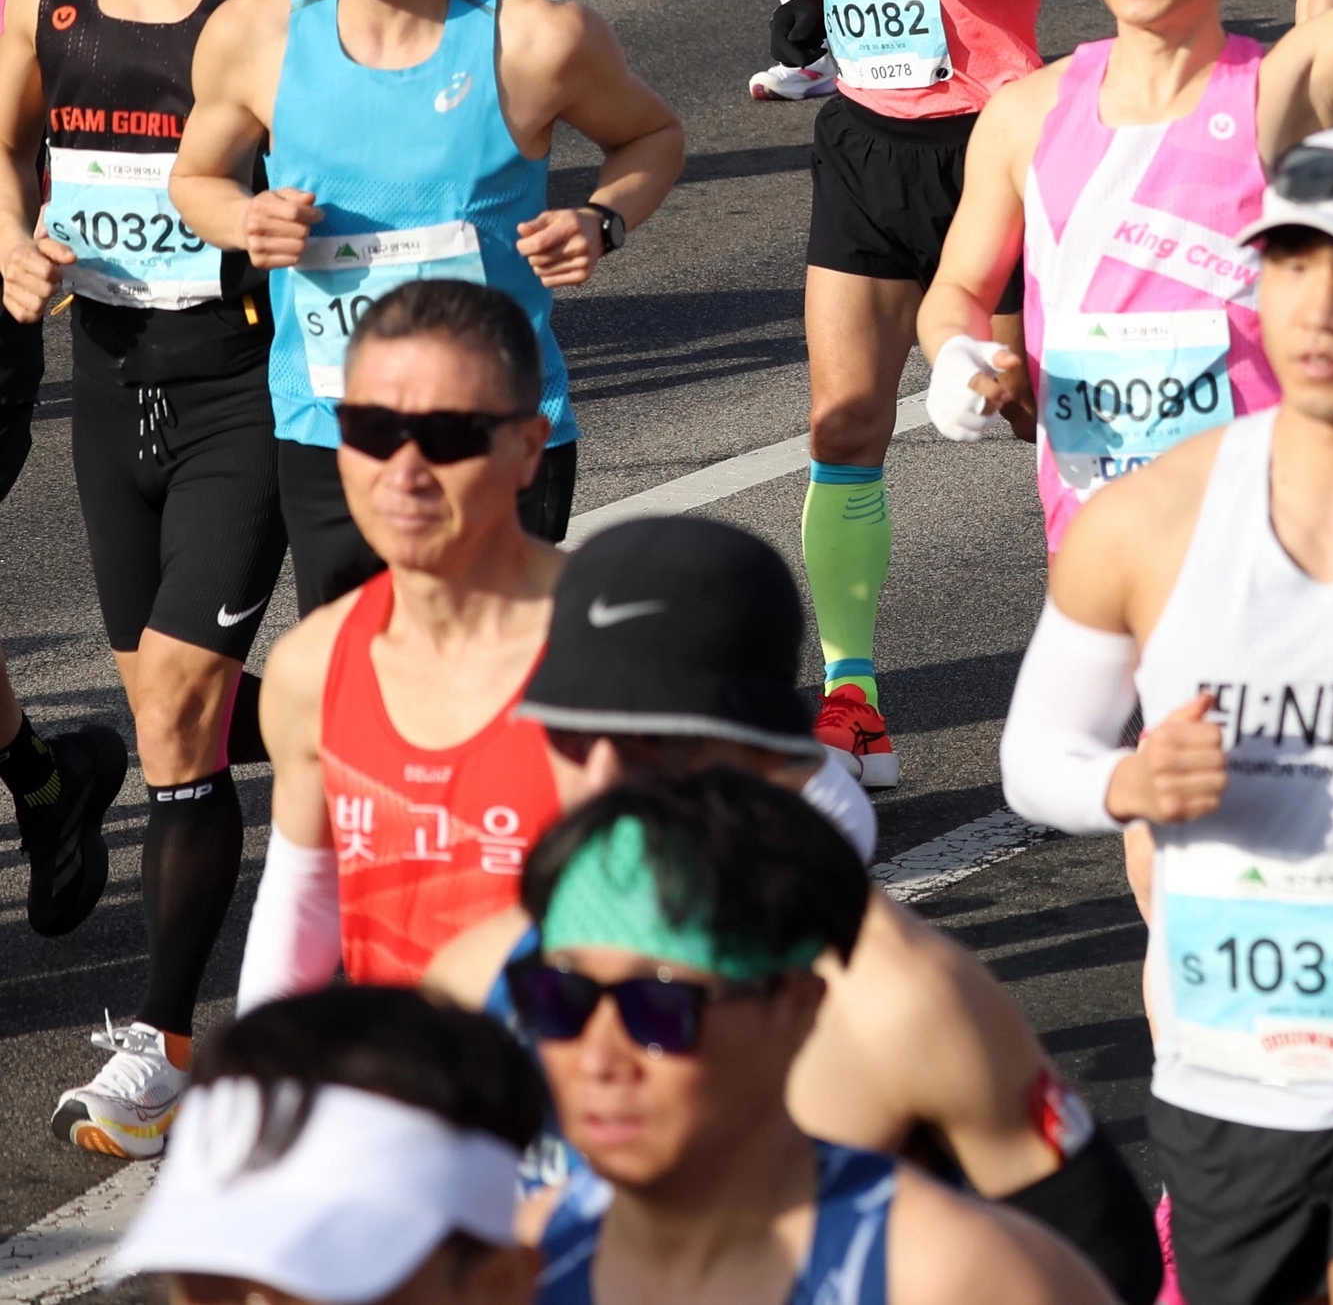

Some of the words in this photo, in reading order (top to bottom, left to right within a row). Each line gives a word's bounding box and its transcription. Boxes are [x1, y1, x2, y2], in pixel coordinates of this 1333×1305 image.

[832, 0, 929, 38] 10182
[871, 63, 913, 80] 00278
[50, 106, 106, 133] TEAM
[112, 110, 187, 139] GORIL
[113, 165, 162, 177] 대구광역시
[52, 222, 71, 242] S
[71, 210, 206, 253] 10329
[1113, 219, 1180, 260] King
[1185, 245, 1262, 286] Crew
[306, 312, 325, 337] S
[1054, 393, 1073, 421] S
[1075, 371, 1219, 423] 10080
[156, 783, 213, 803] cep
[335, 795, 528, 875] 빛고을
[1182, 954, 1205, 985] S
